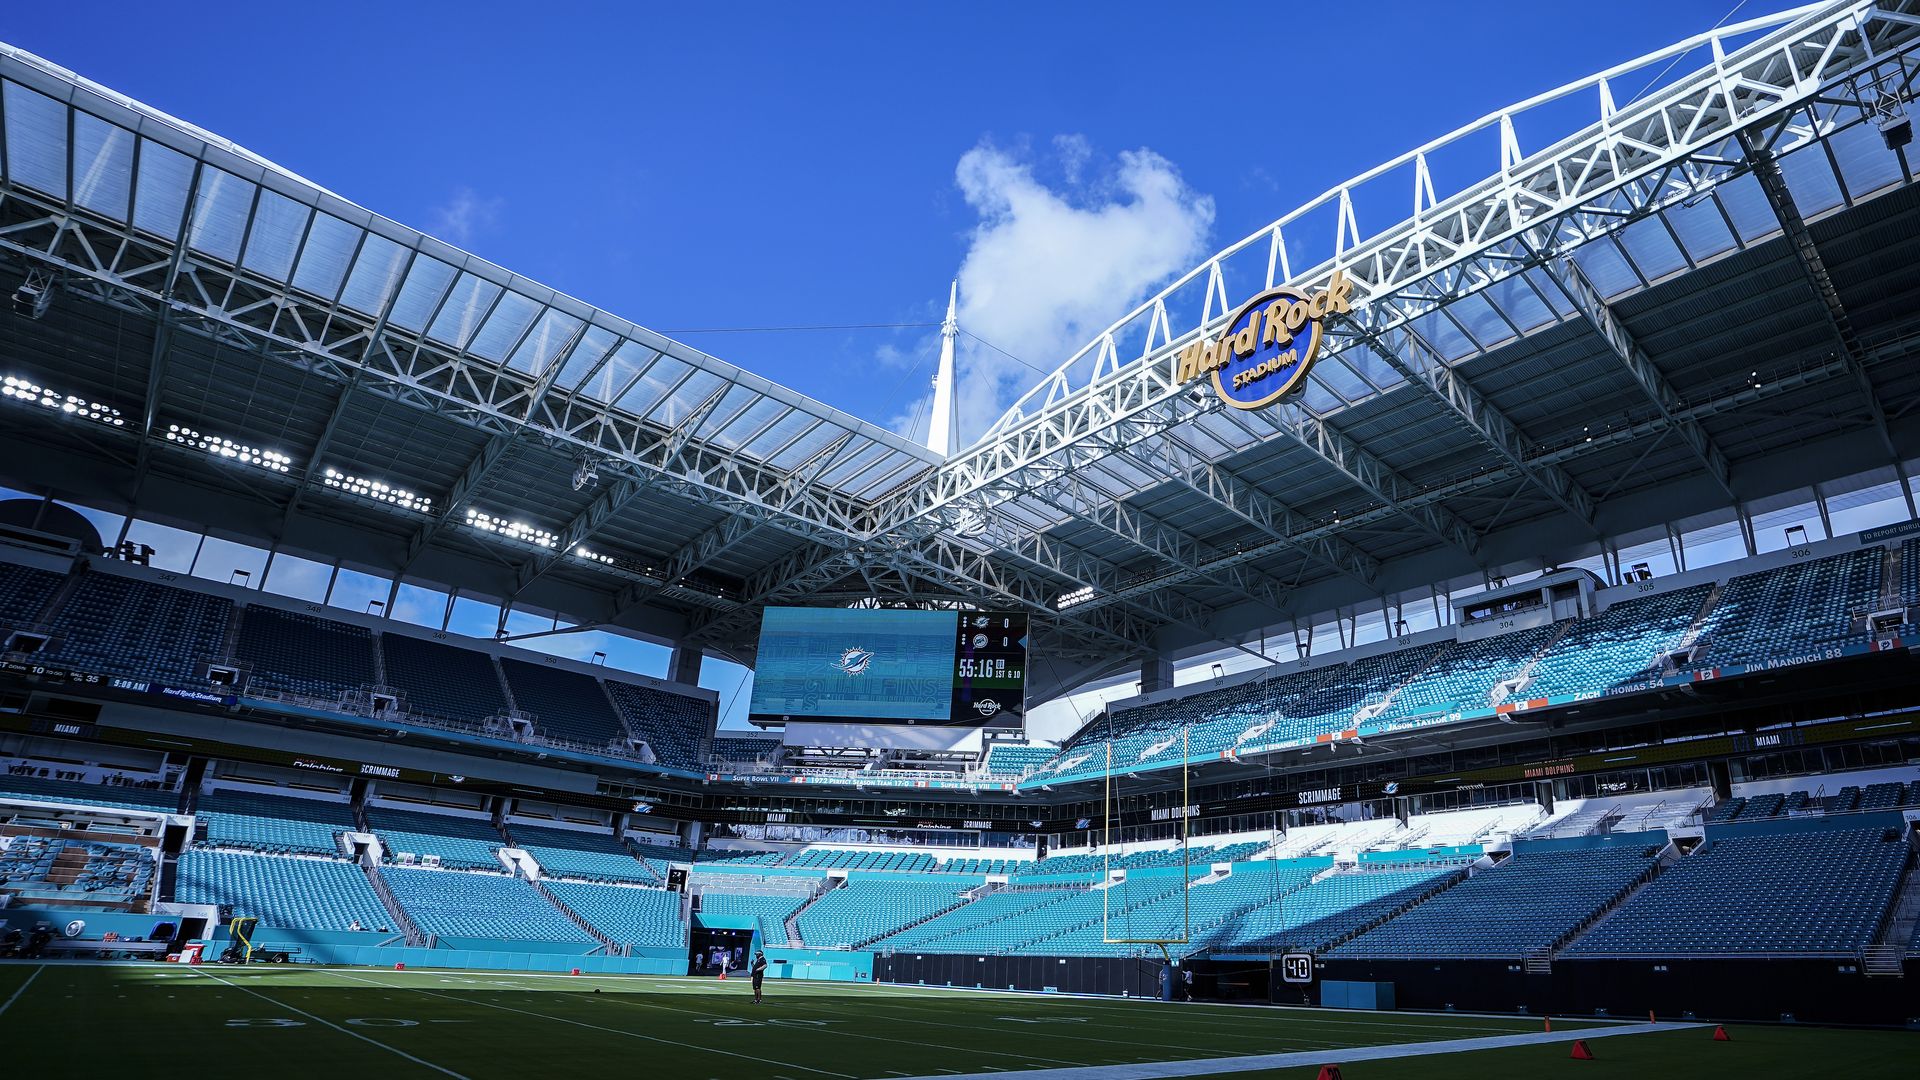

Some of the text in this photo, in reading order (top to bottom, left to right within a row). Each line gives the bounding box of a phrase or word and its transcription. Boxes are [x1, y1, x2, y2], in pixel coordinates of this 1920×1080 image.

[1176, 270, 1354, 385] Hard Rock
[1232, 348, 1298, 390] STADIUM
[1873, 528, 1897, 538] REPORT
[1791, 549, 1811, 559] 306
[159, 574, 177, 582] 347
[1638, 583, 1655, 593] 305
[305, 605, 322, 613] 348
[1004, 618, 1009, 628] 0
[1499, 620, 1514, 629] 304
[432, 632, 447, 640] 349
[1003, 637, 1008, 647] 0
[1744, 648, 1843, 674] JIM MANDICH 88
[31, 666, 45, 674] 10
[959, 659, 993, 678] 55:16
[86, 675, 99, 683] 35
[133, 682, 145, 691] AM
[1573, 679, 1664, 701] ZACH THOMAS 54
[163, 687, 222, 702] Hard Rock Stadium
[973, 701, 1001, 710] Hard Rock
[1387, 713, 1461, 732] JASON TAYLOR 99
[54, 723, 80, 734] MIAMI
[1756, 734, 1780, 747] MIAMI
[361, 764, 400, 778] SCRIMMAGE
[1524, 763, 1575, 778] MIAMI DOLPHINS
[1298, 787, 1341, 804] SCRIMMAGE
[766, 813, 787, 823] MIAMI
[1151, 808, 1170, 821] MIAMI
[963, 820, 992, 829] SCRIMMAGE
[1286, 959, 1308, 977] 40
